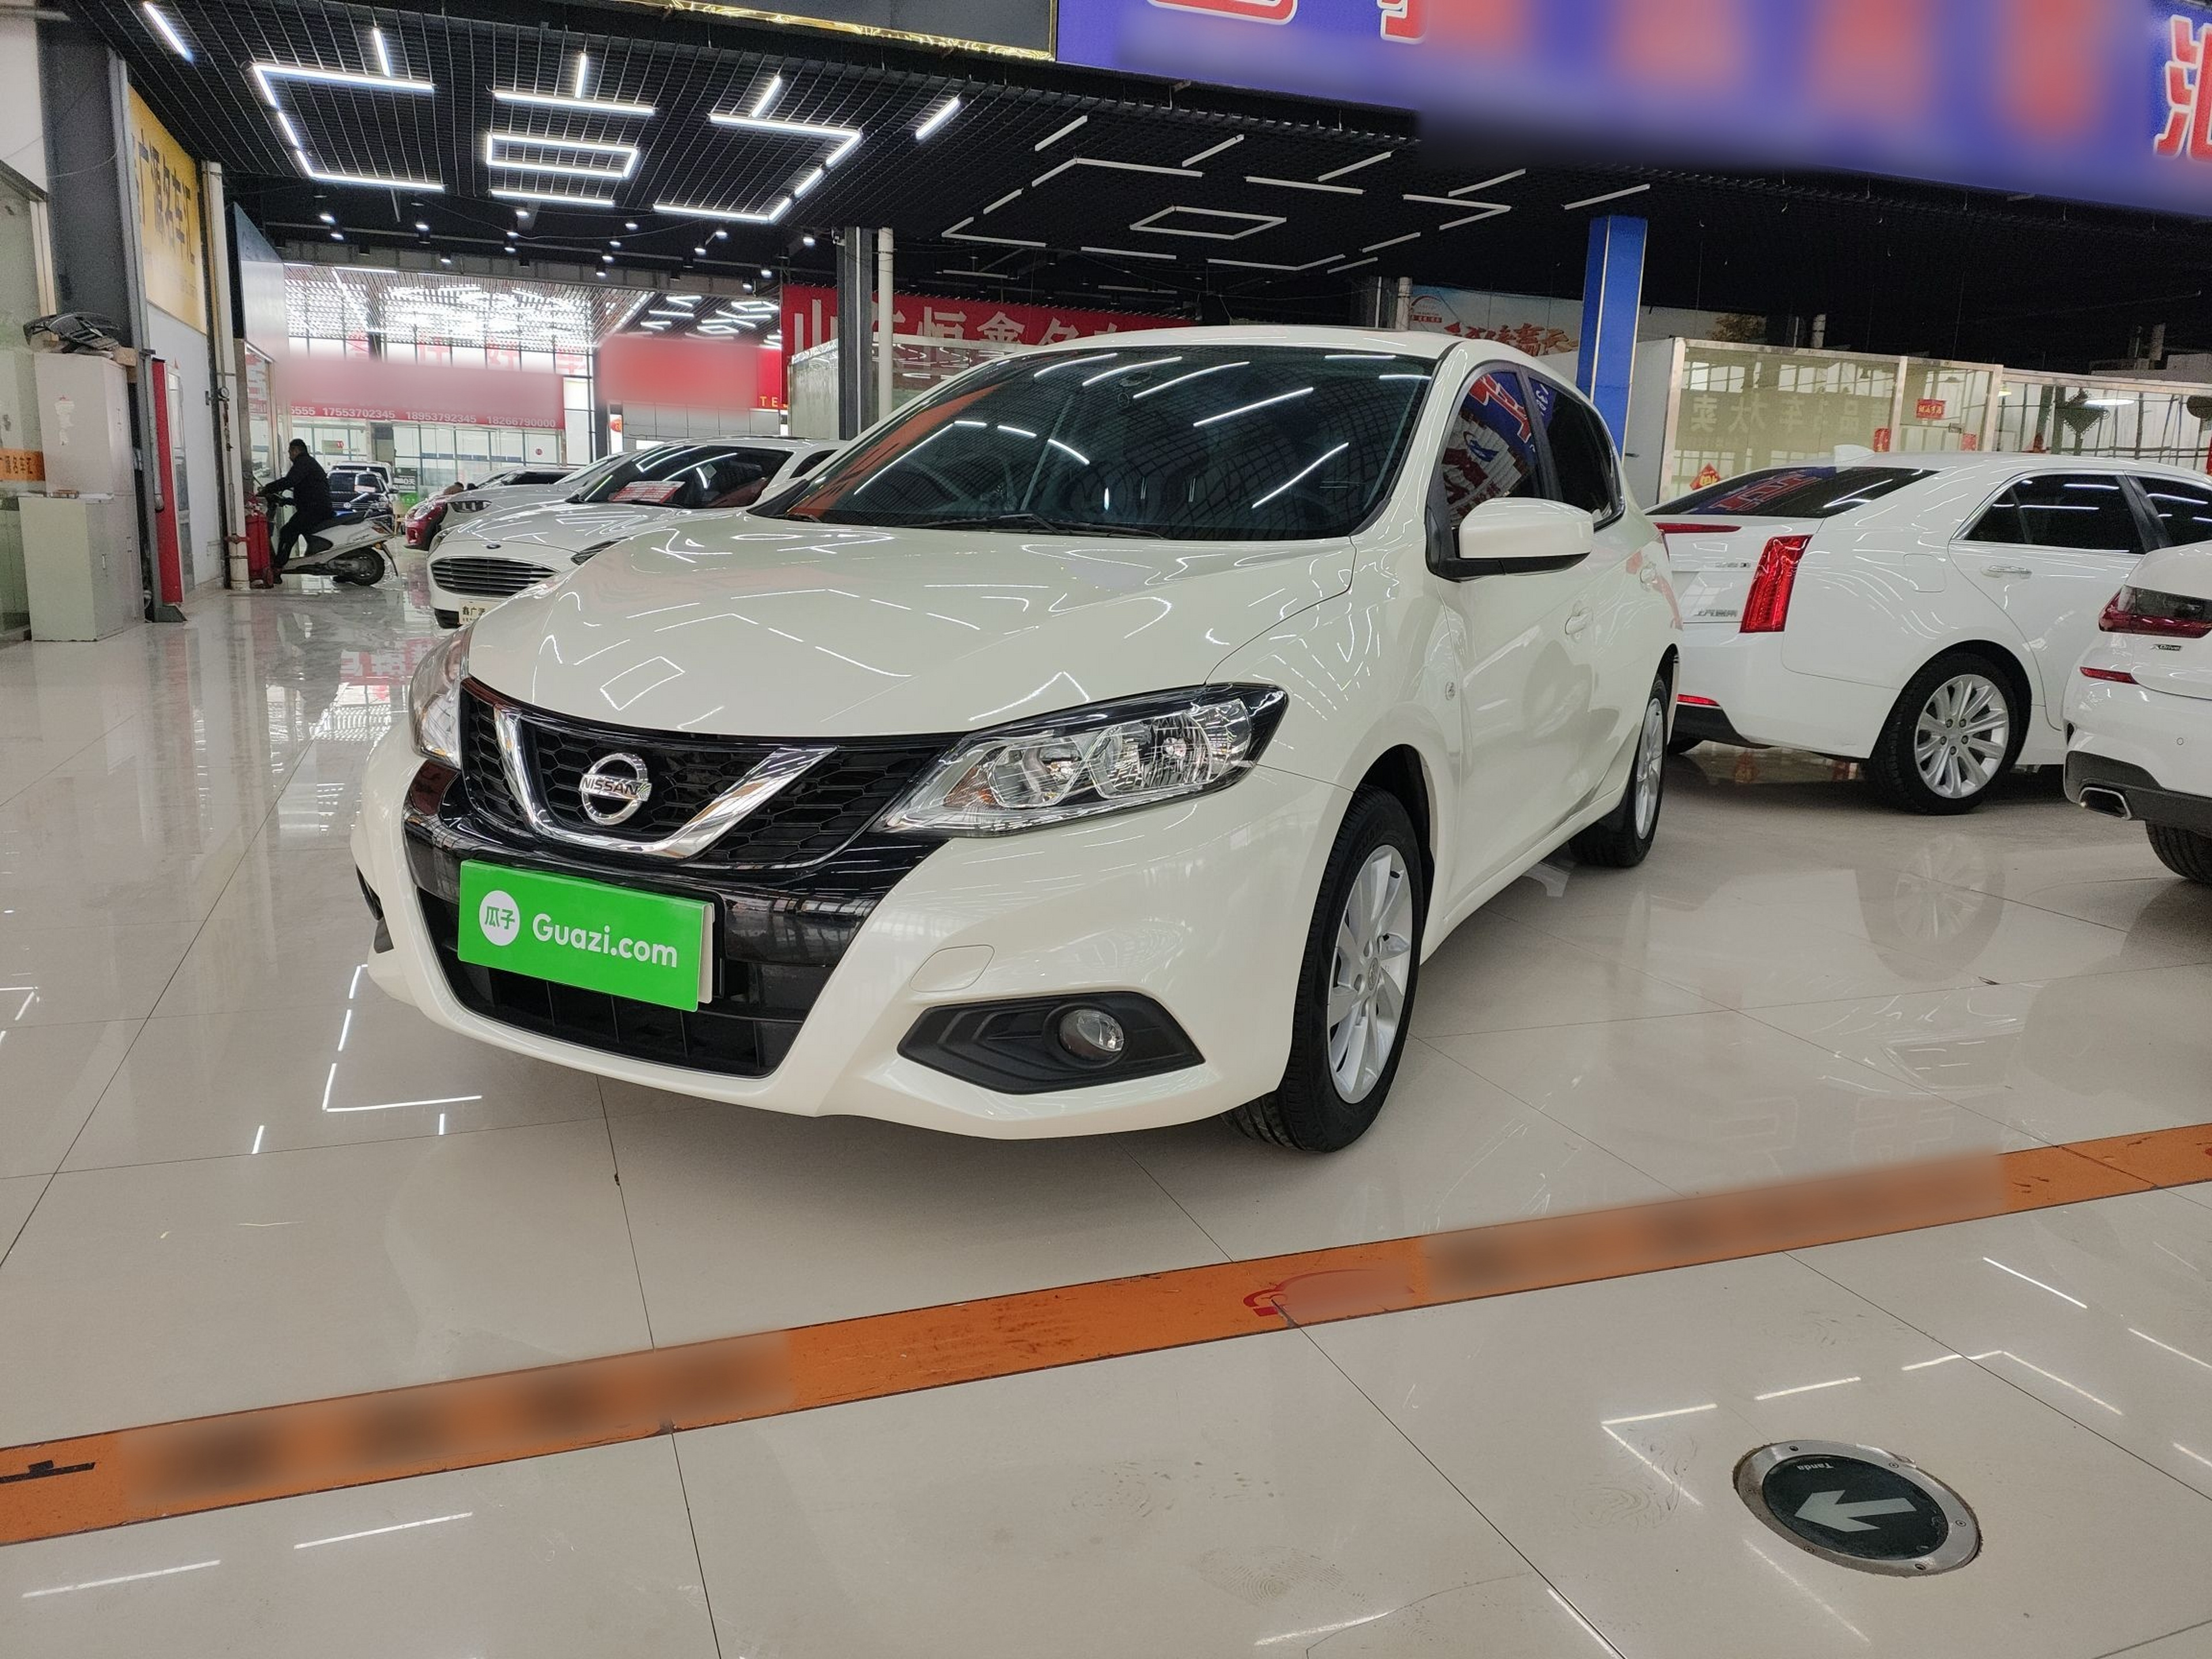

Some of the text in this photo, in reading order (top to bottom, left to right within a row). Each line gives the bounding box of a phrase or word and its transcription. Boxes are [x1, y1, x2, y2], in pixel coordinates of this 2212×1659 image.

[323, 407, 396, 419] 17553702345
[405, 411, 477, 424] 18953792345
[487, 415, 556, 428] 18266790000
[581, 777, 639, 796] NISSAN
[485, 906, 677, 968] 瓜子 Guazi.com
[1797, 1463, 1835, 1471] Tanda
